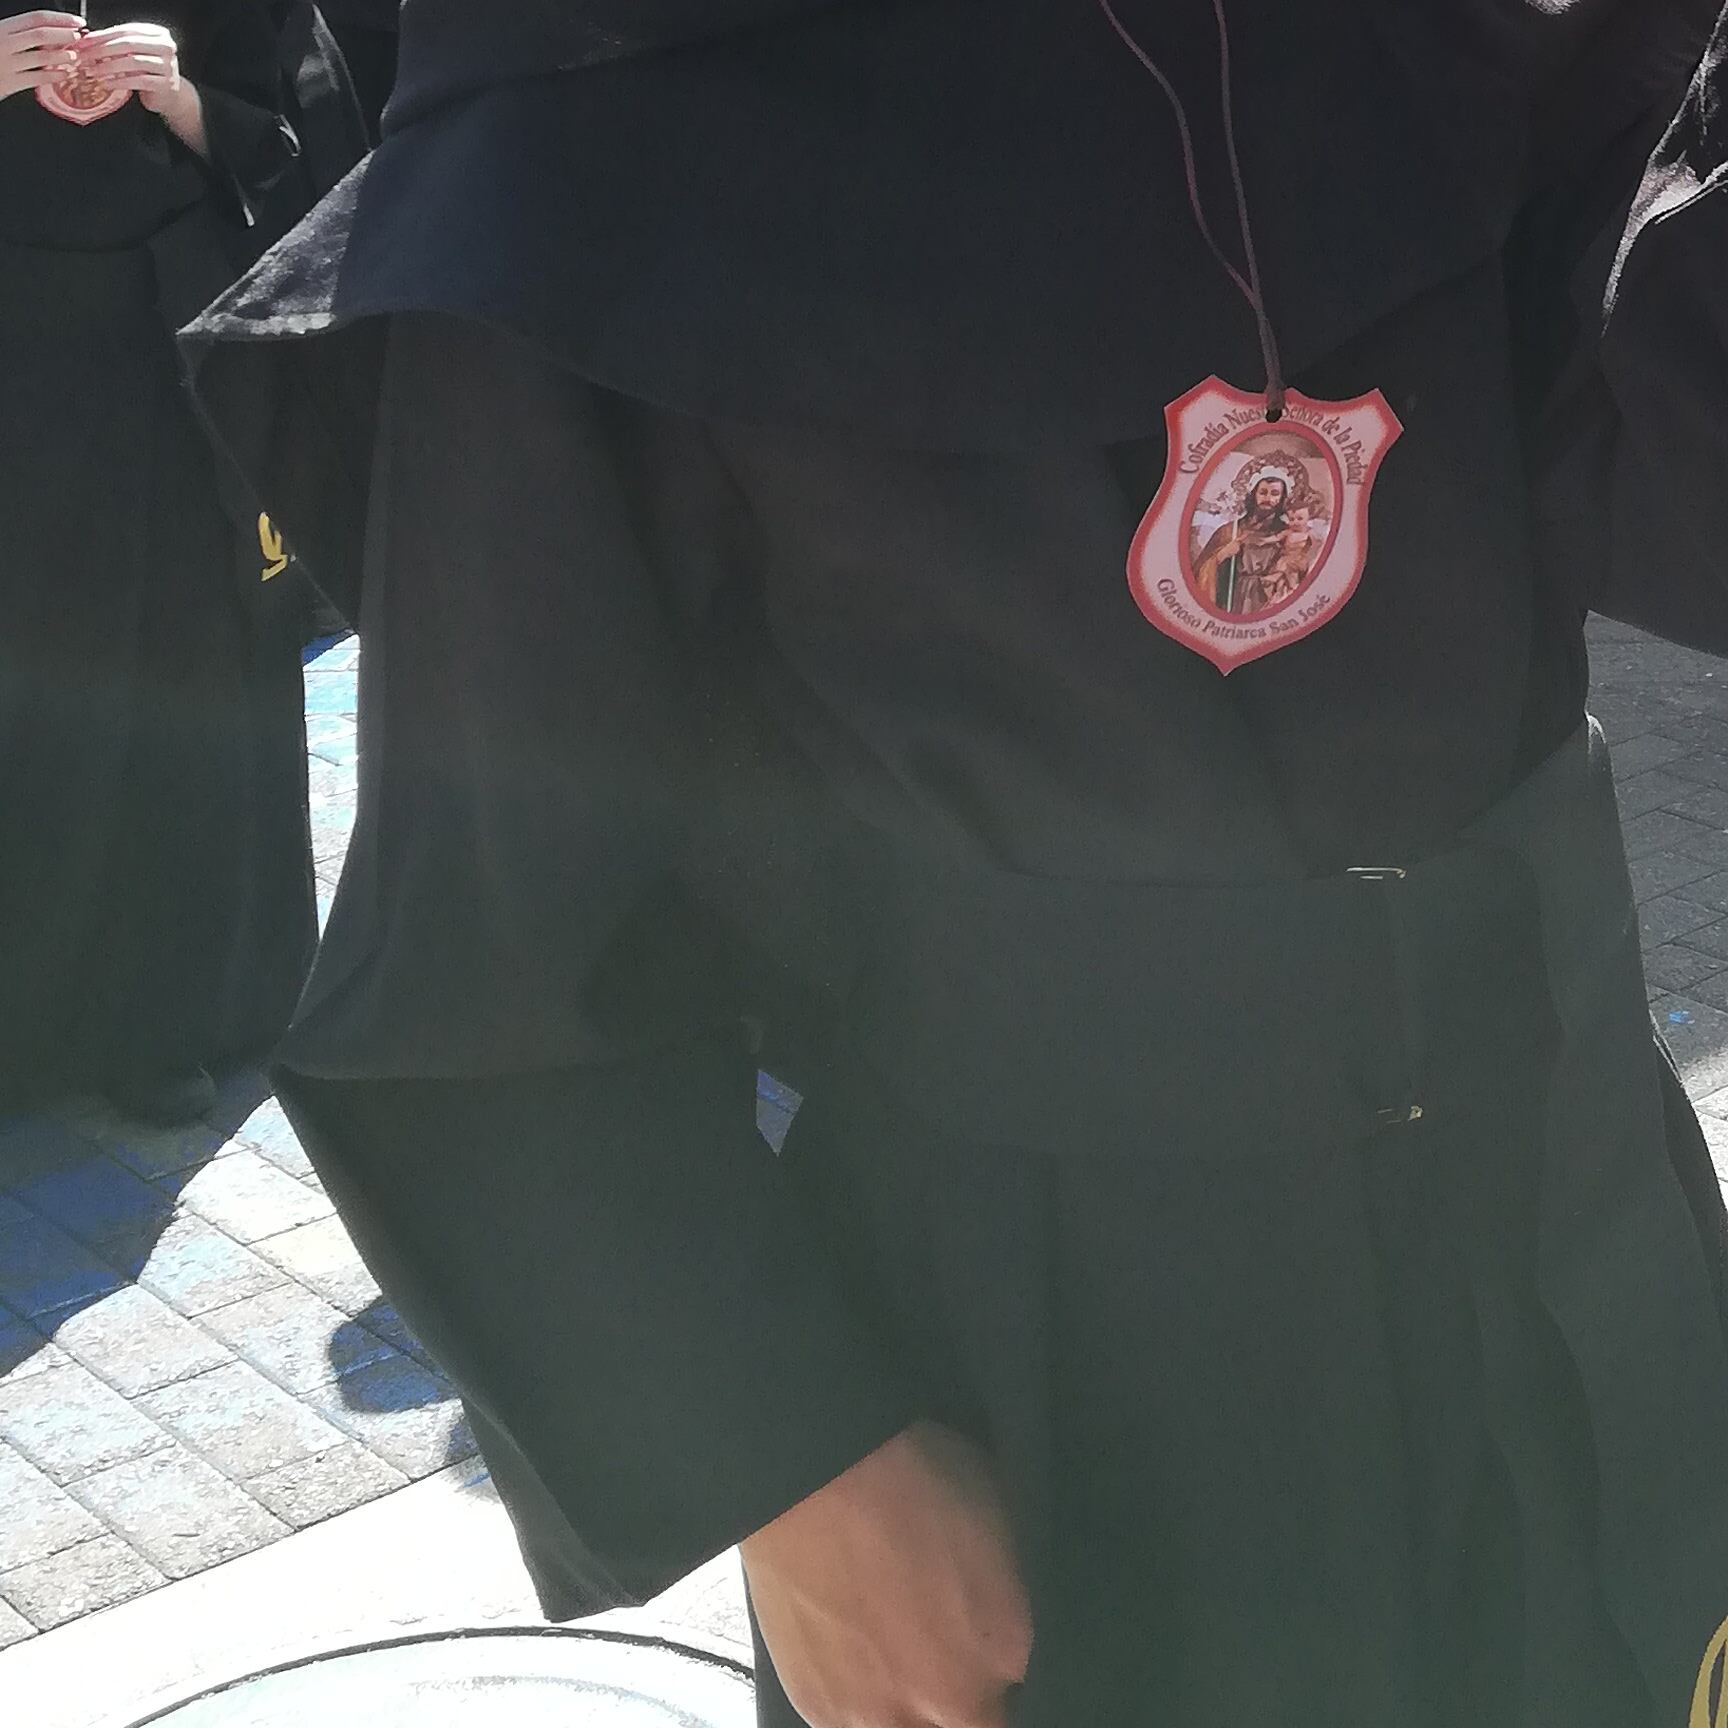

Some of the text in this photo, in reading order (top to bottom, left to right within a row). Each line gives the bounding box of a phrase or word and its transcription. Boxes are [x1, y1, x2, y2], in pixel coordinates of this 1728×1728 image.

[1321, 416, 1340, 434] de
[1333, 426, 1352, 444] la
[1341, 440, 1369, 485] Piedad
[1157, 578, 1330, 640] Glorioso Patriarca San José
